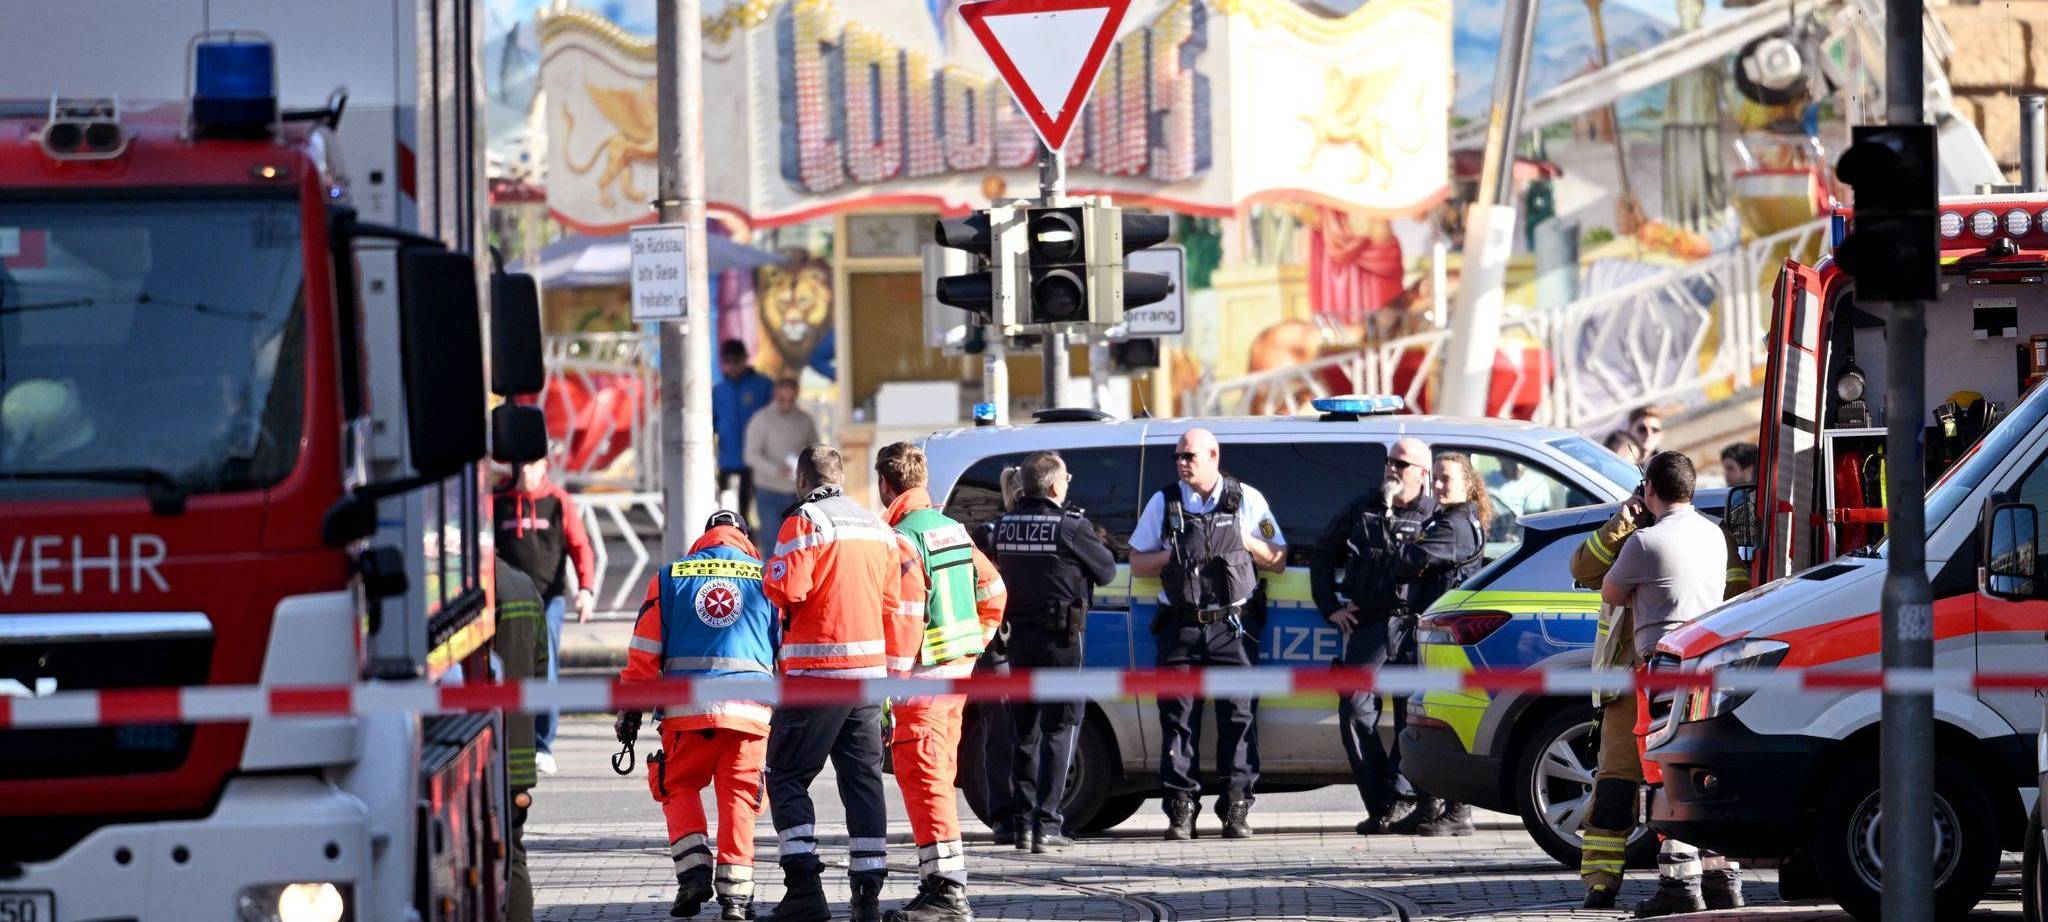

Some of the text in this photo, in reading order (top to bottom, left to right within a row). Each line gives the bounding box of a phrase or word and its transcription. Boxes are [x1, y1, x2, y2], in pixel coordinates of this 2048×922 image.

[647, 237, 682, 254] Rückstau
[998, 523, 1056, 541] POLIZEI
[700, 582, 740, 599] JOHANNITER
[699, 606, 739, 625] UNFALL-HILFE
